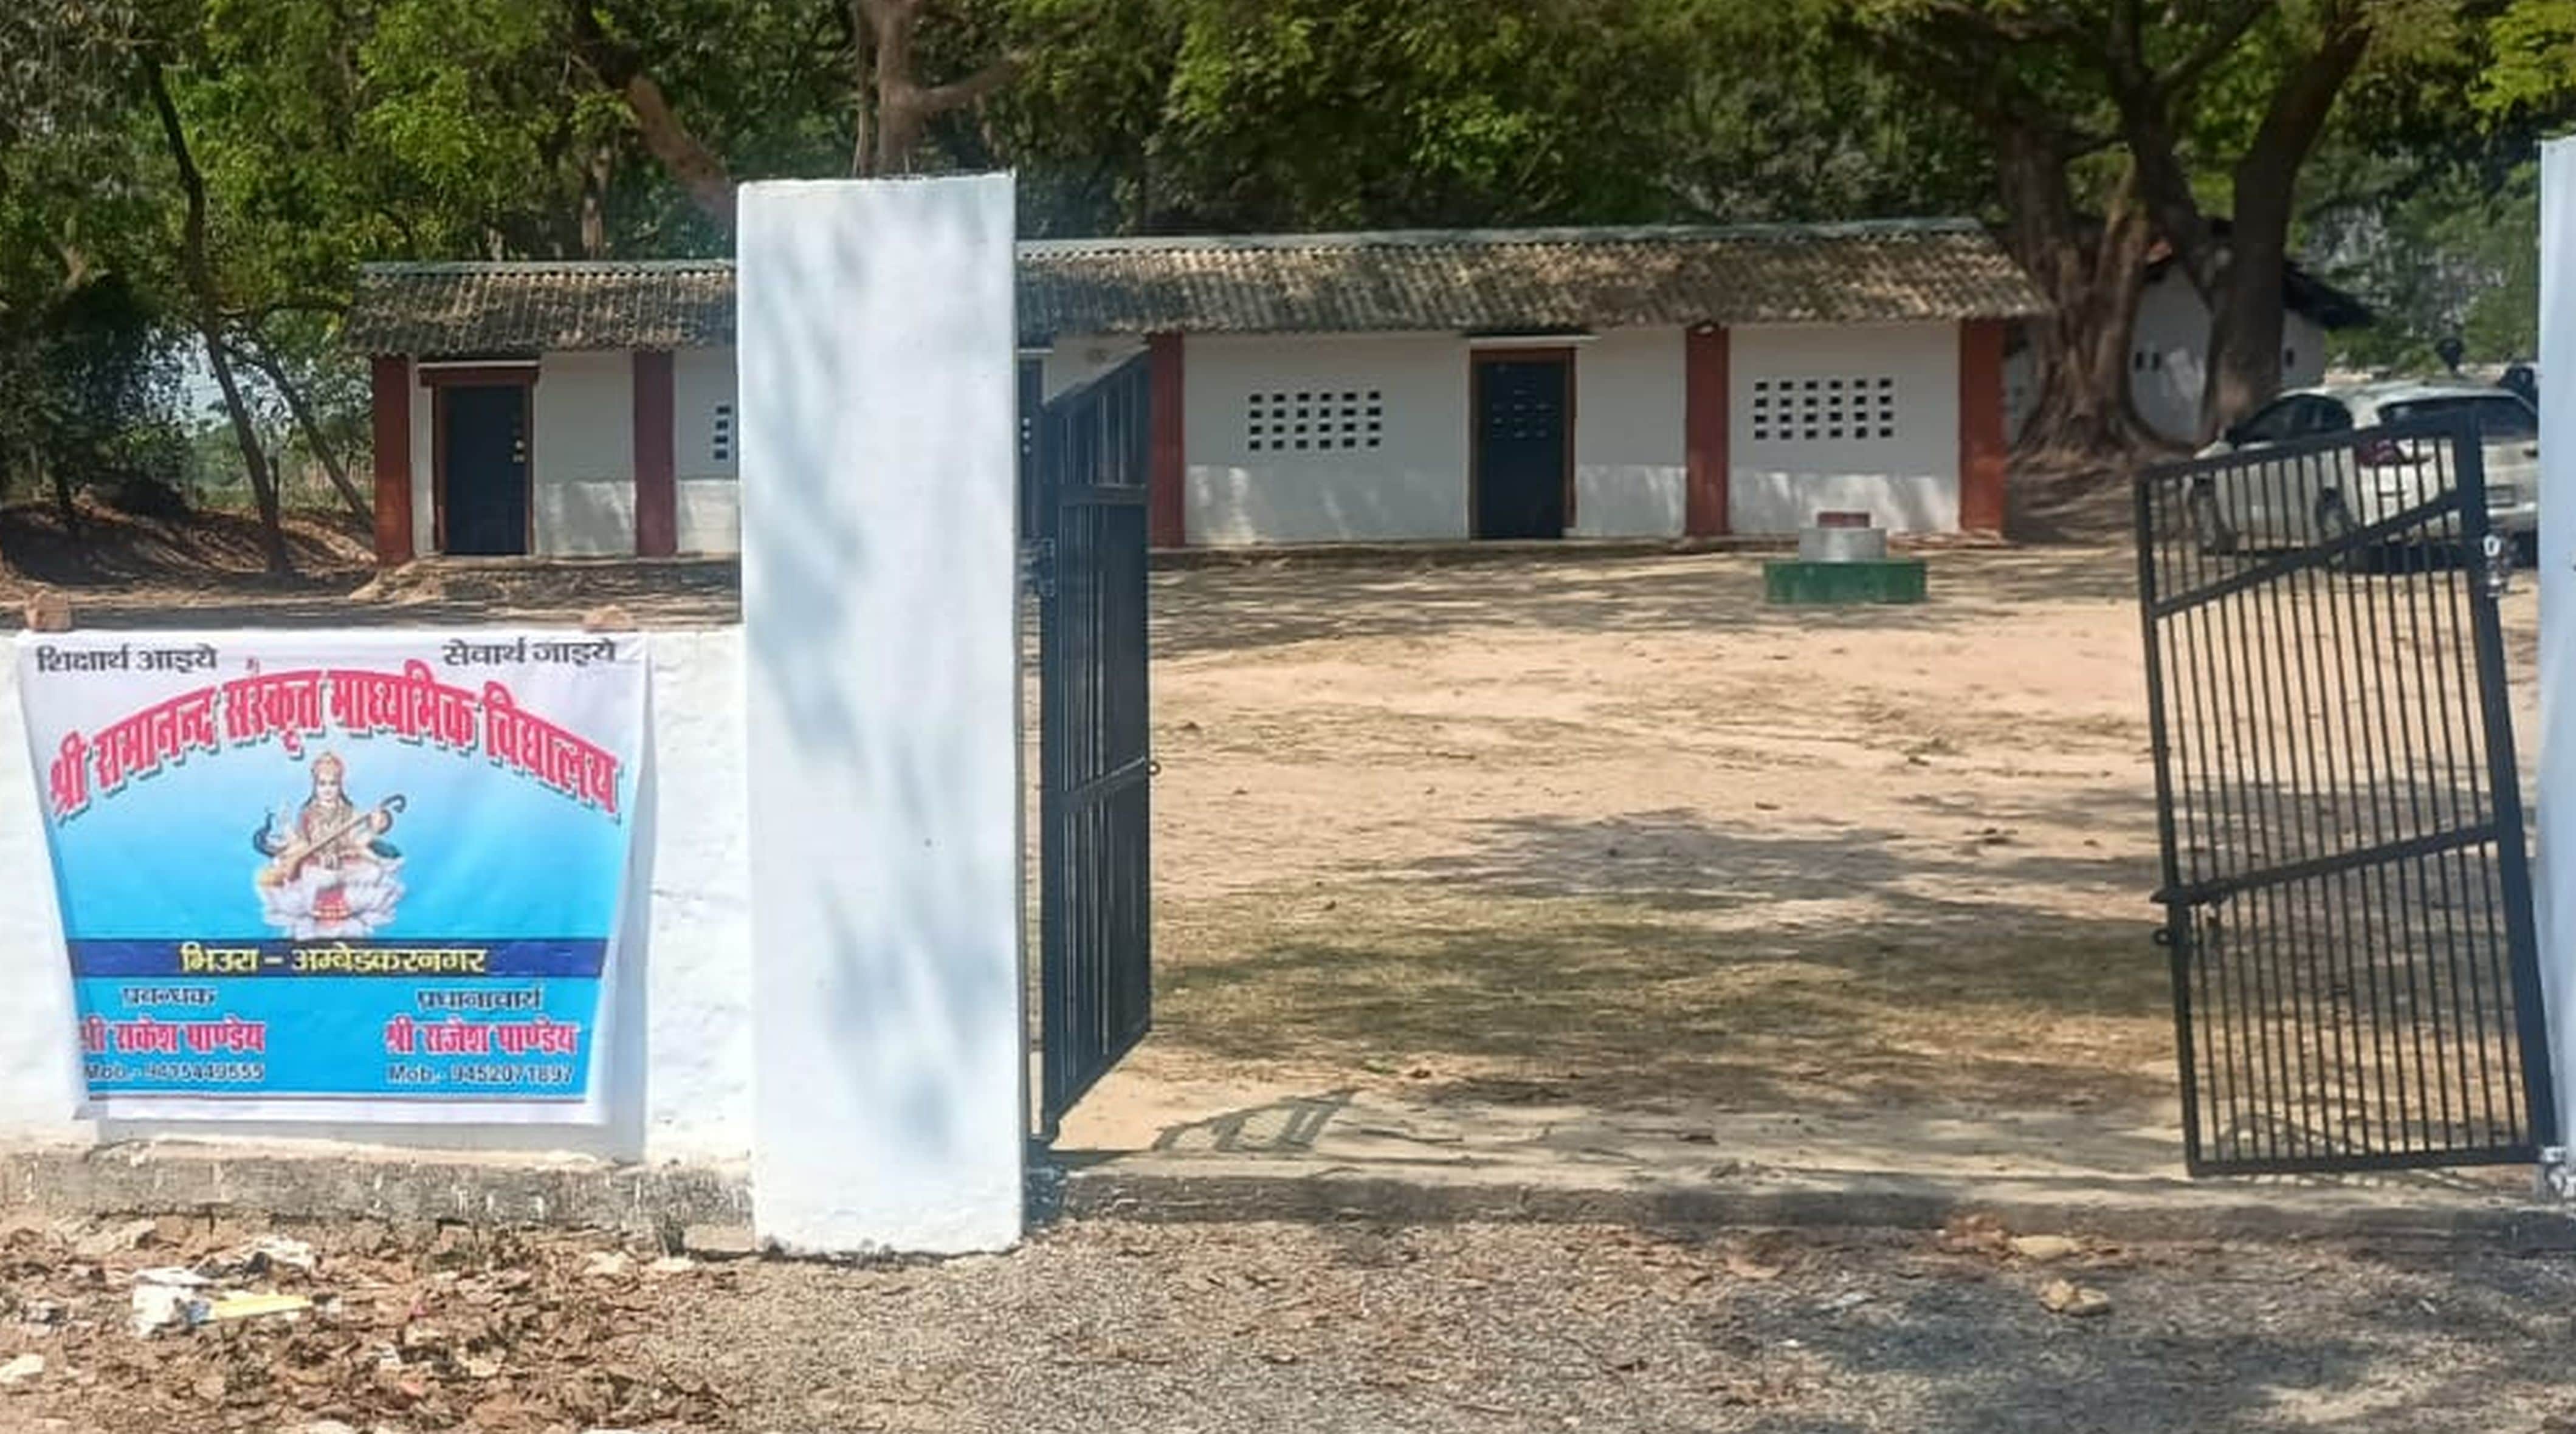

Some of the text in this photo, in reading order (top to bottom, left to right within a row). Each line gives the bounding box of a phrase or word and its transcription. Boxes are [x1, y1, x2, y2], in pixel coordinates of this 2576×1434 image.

[36, 642, 218, 673] शिक्षार्थ आइये
[442, 637, 617, 667] सेवार्थ जाइये
[50, 657, 620, 819] श्री रामानन्द संस्कृत माध्यमिक विद्यालय
[114, 1015, 178, 1052] राकेश
[184, 1014, 265, 1052] पाण्डेय
[387, 1014, 579, 1053] श्री राजेश पाण्डेय
